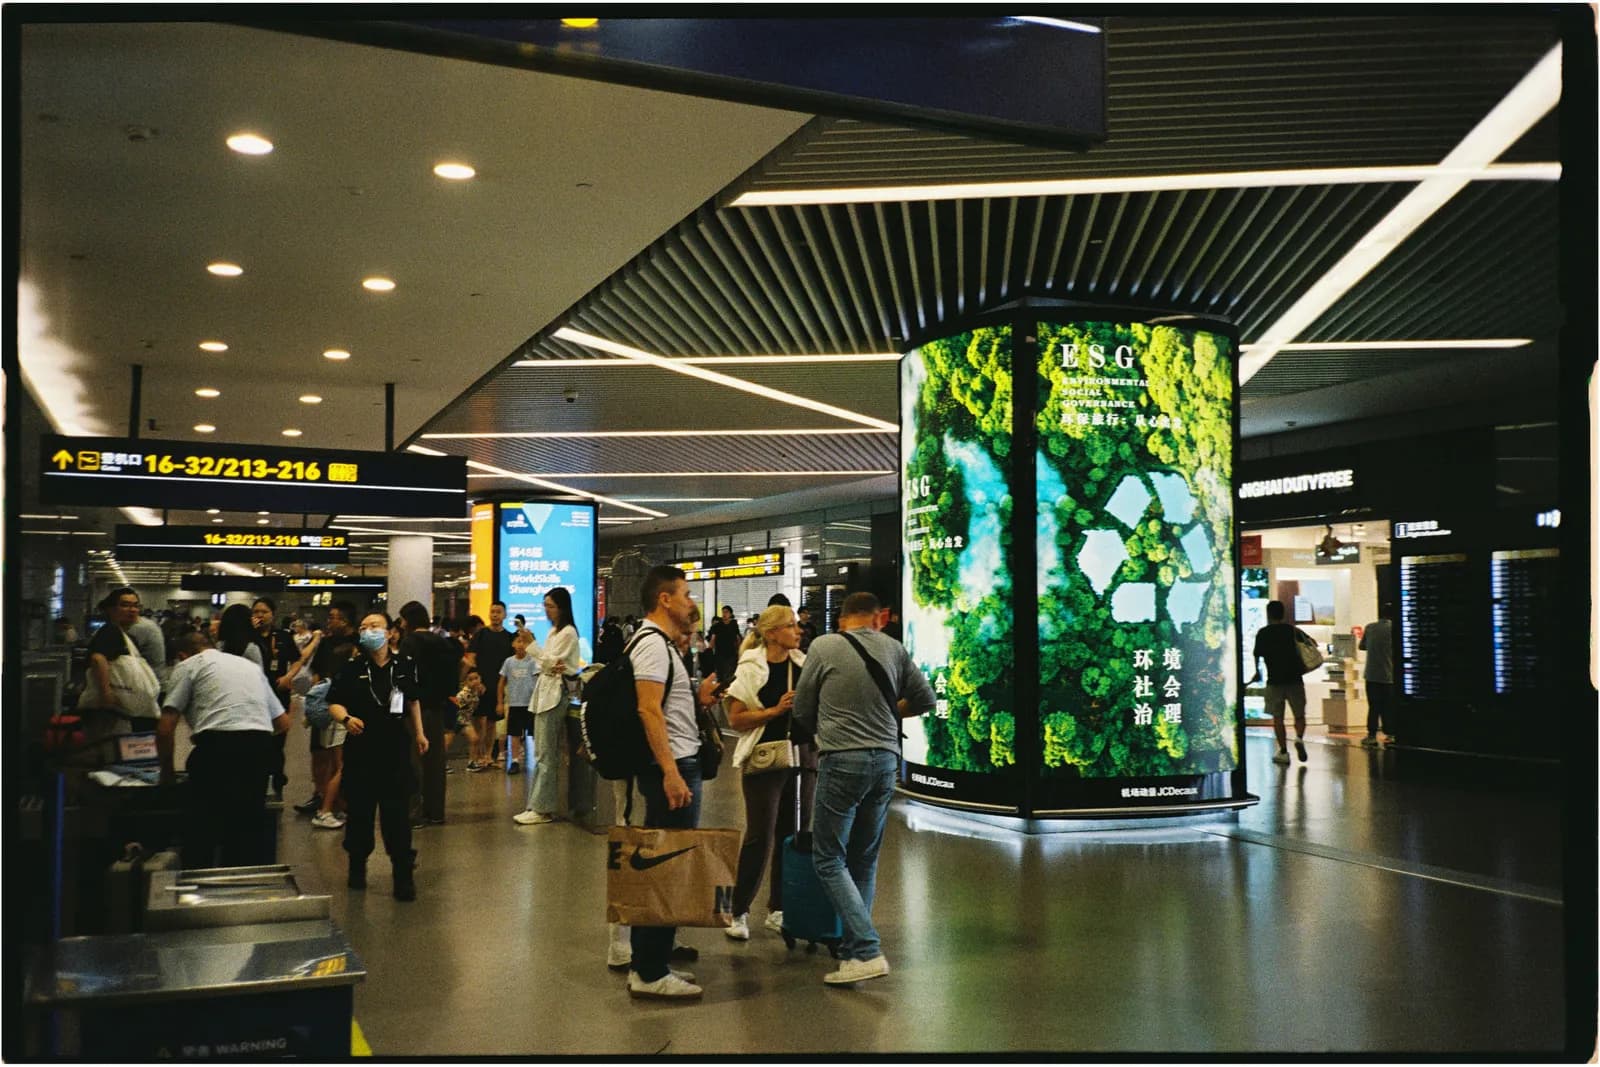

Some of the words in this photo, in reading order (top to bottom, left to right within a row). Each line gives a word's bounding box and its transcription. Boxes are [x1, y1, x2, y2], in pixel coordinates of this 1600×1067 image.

[1060, 343, 1135, 369] ESG
[1062, 388, 1102, 396] SOCIAL
[1062, 399, 1136, 409] GOVERNANCE
[144, 454, 321, 480] 16-32/213-216
[203, 533, 300, 546] 16-32/213-216
[508, 574, 561, 583] WorldSkills
[1133, 648, 1182, 671] 环境
[1133, 675, 1182, 698] 社会
[1133, 702, 1183, 725] 治理
[1157, 786, 1199, 797] JCDecaux
[216, 1037, 288, 1055] WARNING
